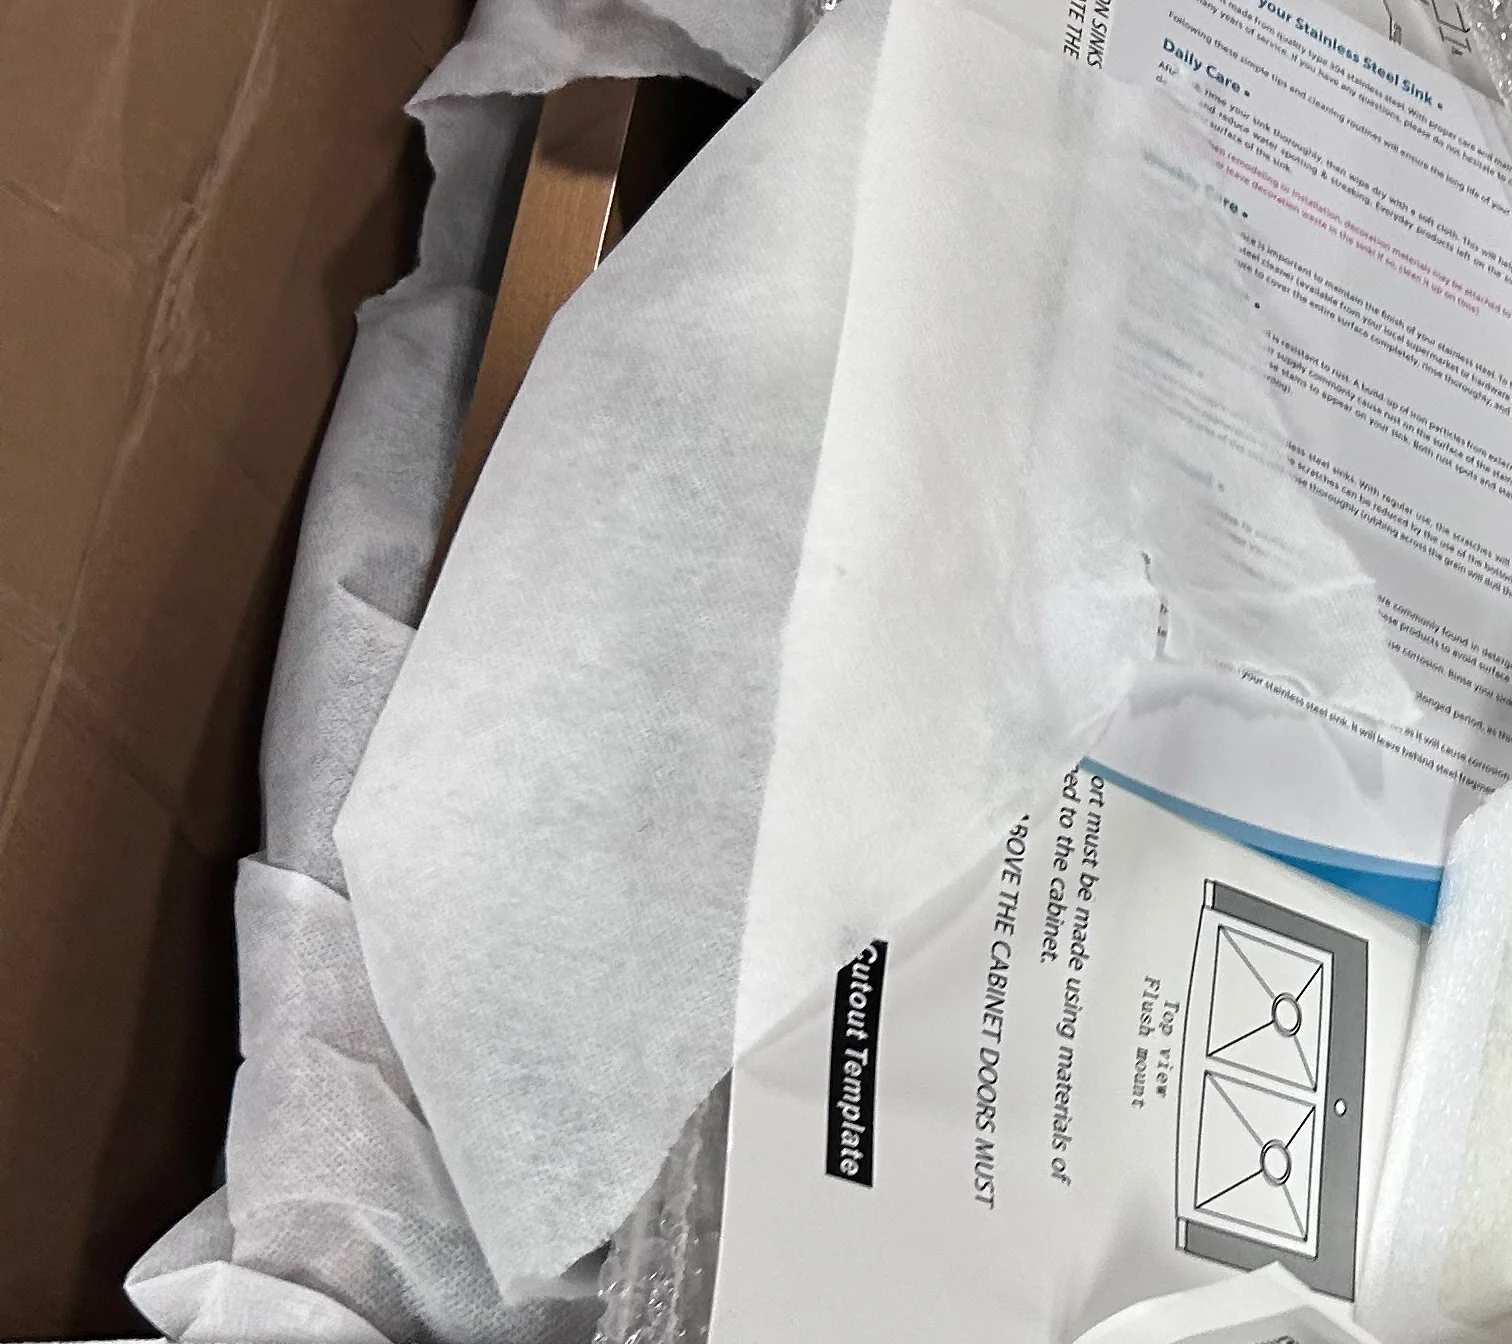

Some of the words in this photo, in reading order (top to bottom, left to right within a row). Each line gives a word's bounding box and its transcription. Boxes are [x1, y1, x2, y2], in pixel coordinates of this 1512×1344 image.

[1063, 24, 1083, 60] THE
[1087, 17, 1107, 69] SINKS
[1160, 37, 1203, 72] Daily
[1203, 63, 1242, 93] Care
[1292, 14, 1362, 64] Stainless
[1360, 54, 1402, 87] Steel
[1398, 78, 1436, 107] Sink
[1167, 10, 1213, 46] Following
[1212, 39, 1238, 59] these
[1239, 56, 1270, 78] simple
[1269, 73, 1289, 89] tips
[1288, 85, 1308, 99] and
[1306, 95, 1345, 123] cleaning
[1345, 118, 1382, 143] routines
[1382, 139, 1400, 153] will
[1398, 149, 1430, 170] ensure
[1428, 165, 1445, 179] the
[1444, 172, 1466, 192] long
[1464, 184, 1480, 198] life
[1479, 194, 1492, 205] of
[1490, 201, 1511, 216] your
[1227, 104, 1250, 120] your
[1251, 117, 1272, 133] sink
[1271, 128, 1320, 164] thoroughly,
[1324, 159, 1347, 177] then
[1347, 173, 1370, 190] wipe
[1370, 185, 1387, 201] dry
[1387, 196, 1410, 212] with
[1409, 208, 1417, 216] a
[1417, 212, 1436, 226] soft
[1460, 235, 1480, 251] This
[1479, 247, 1498, 261] will
[1252, 269, 1264, 281] to
[1264, 276, 1290, 295] cover
[1290, 290, 1308, 305] the
[1307, 300, 1335, 320] entire
[1335, 316, 1369, 339] surface
[1419, 363, 1443, 379] rinse
[1442, 374, 1492, 408] thoroughly,
[1492, 402, 1512, 416] and
[1265, 246, 1312, 277] important
[1311, 272, 1324, 284] to
[1323, 280, 1364, 306] maintain
[1363, 301, 1380, 315] the
[1378, 309, 1406, 329] finish
[1404, 325, 1417, 335] of
[1414, 331, 1436, 346] your
[1435, 342, 1474, 367] stainless
[1495, 373, 1508, 386] To
[1306, 453, 1331, 470] steel
[1356, 478, 1381, 497] With
[1380, 493, 1413, 515] regular
[1434, 521, 1450, 535] the
[1451, 531, 1494, 558] scratches
[1494, 554, 1512, 566] will
[1398, 621, 1440, 646] products
[1439, 641, 1452, 652] to
[1451, 648, 1478, 666] avoid
[1477, 661, 1510, 682] surface
[1001, 813, 1030, 887] BOVE
[1058, 806, 1077, 829] to
[1081, 811, 1102, 869] must
[1052, 834, 1076, 872] the
[993, 891, 1020, 937] THE
[1077, 871, 1100, 902] be
[1039, 877, 1068, 965] cabinet.
[1068, 906, 1090, 972] made
[845, 944, 878, 1041] Cutout
[981, 940, 1012, 1044] CABINET
[1055, 976, 1083, 1041] using
[1138, 975, 1161, 1037] Flush
[1158, 1000, 1180, 1037] Top
[975, 1047, 1000, 1134] DOORS
[1051, 1045, 1074, 1152] materials
[1131, 1046, 1148, 1110] mount
[1156, 1048, 1174, 1098] view
[837, 1047, 870, 1177] Template
[974, 1137, 995, 1211] MUST
[1051, 1157, 1072, 1187] of
